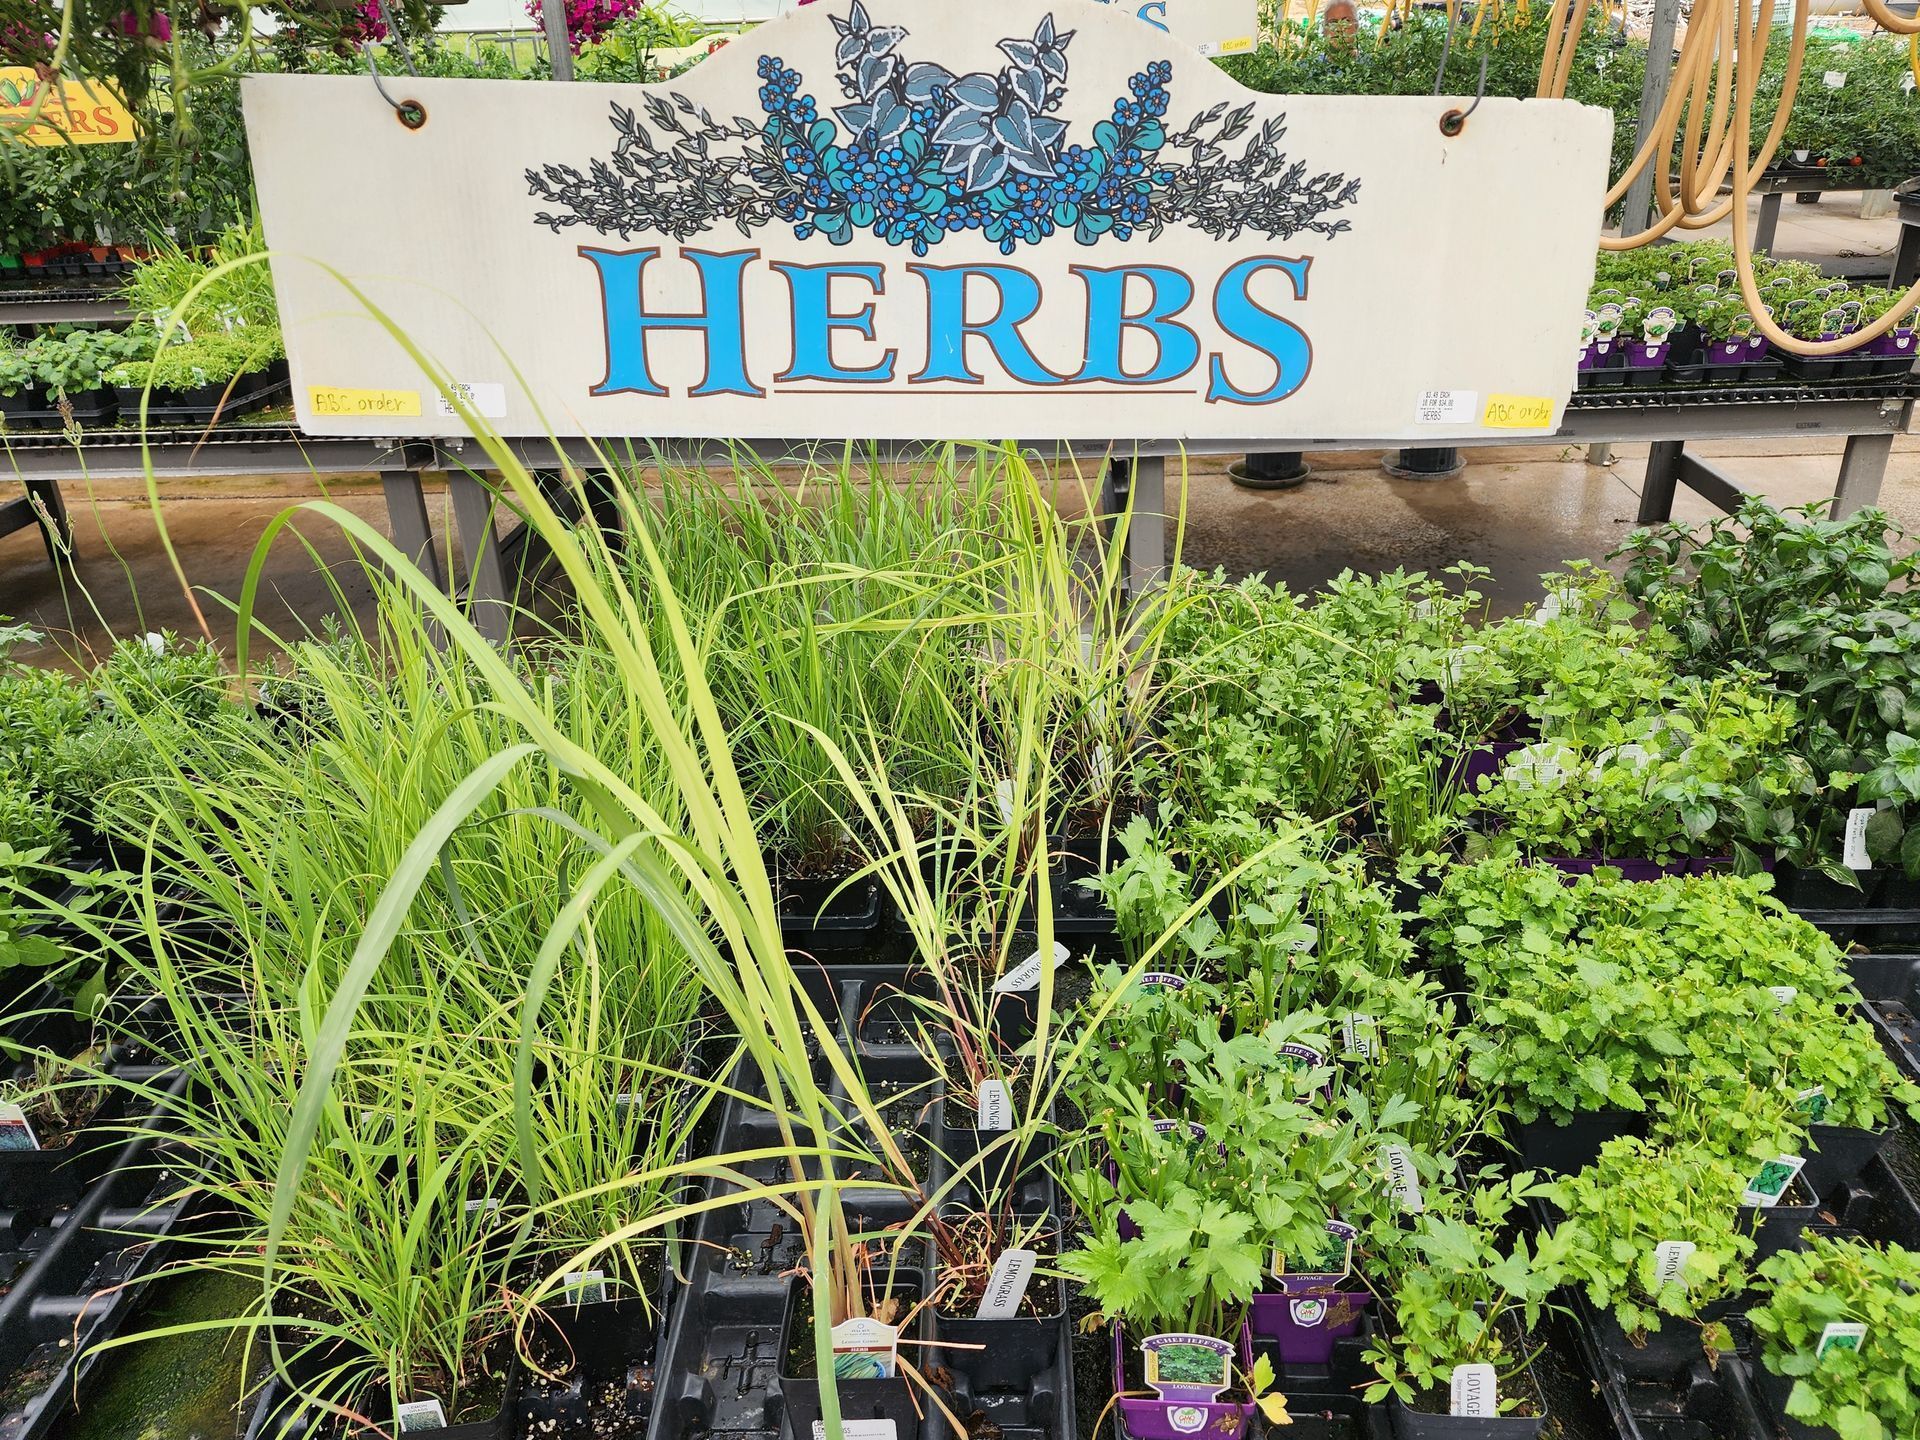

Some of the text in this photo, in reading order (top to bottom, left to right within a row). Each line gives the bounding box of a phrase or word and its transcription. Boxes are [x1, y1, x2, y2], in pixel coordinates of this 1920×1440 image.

[577, 246, 1314, 404] HERBS
[315, 393, 404, 413] ABC order
[1487, 403, 1515, 422] ABC
[1422, 410, 1442, 421] HERBS
[1285, 1046, 1311, 1058] JEFF'S
[1663, 1246, 1681, 1277] LEMON
[993, 1258, 1023, 1308] LEMONGRASS
[1156, 1337, 1219, 1350] CHEF JEFF'S
[1467, 1372, 1481, 1416] LOVAGE
[1179, 1414, 1196, 1422] GMO
